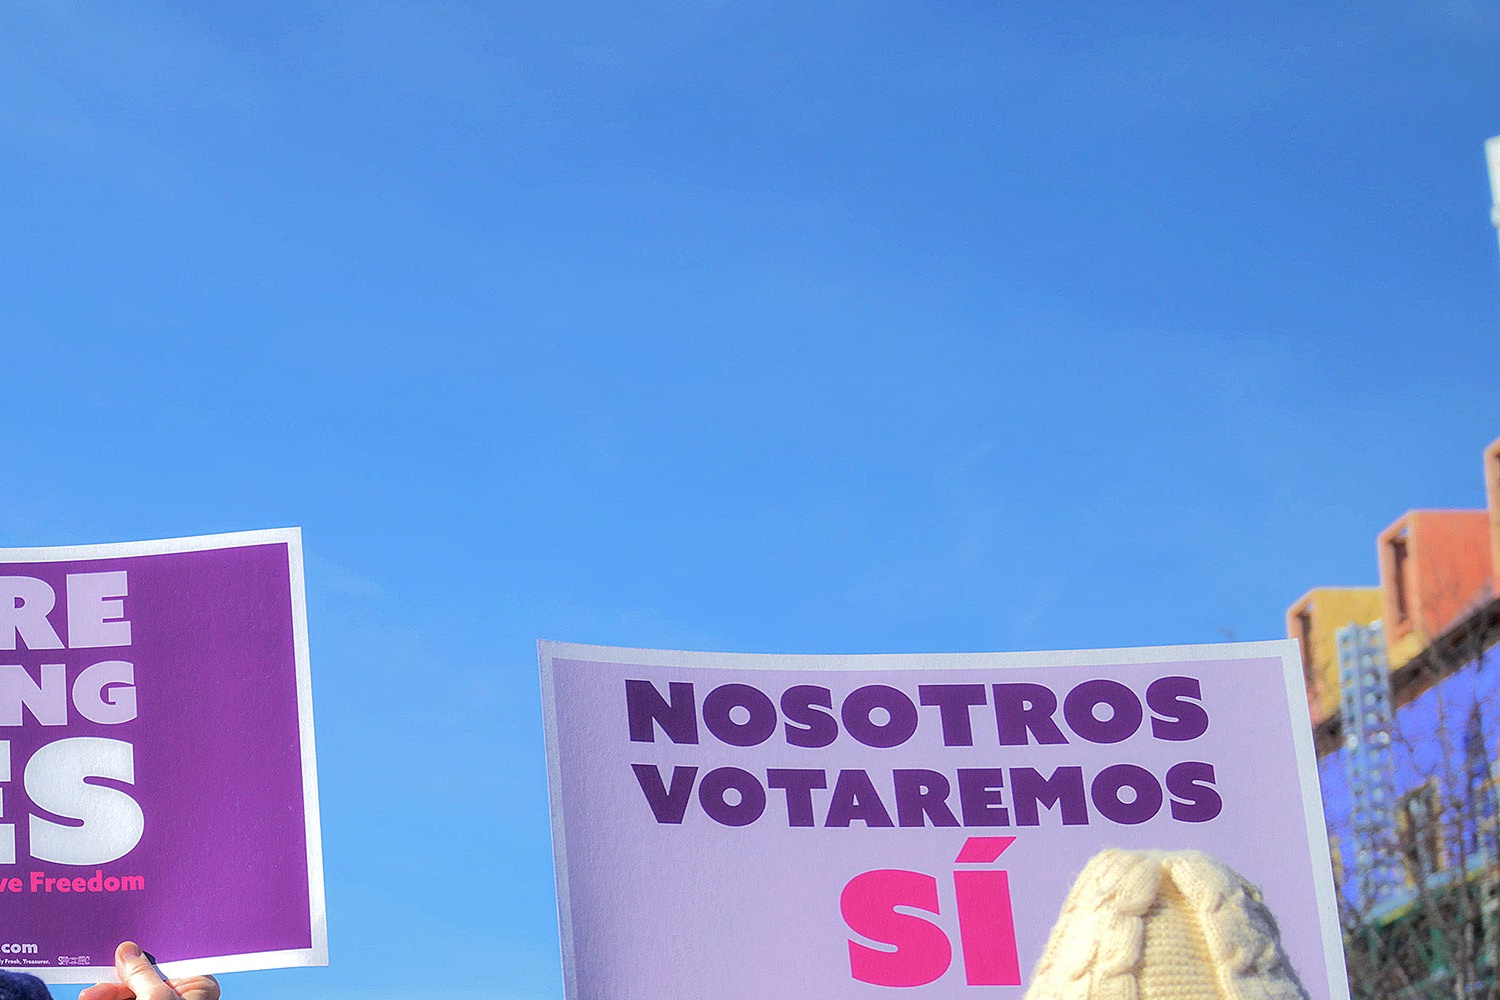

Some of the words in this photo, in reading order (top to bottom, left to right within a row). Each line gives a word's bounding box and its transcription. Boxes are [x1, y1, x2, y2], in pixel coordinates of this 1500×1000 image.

[624, 676, 1209, 749] NOSOTROS
[630, 761, 1223, 828] VOTAREMOS
[29, 870, 146, 893] Freedom
[839, 835, 1023, 989] SÍ
